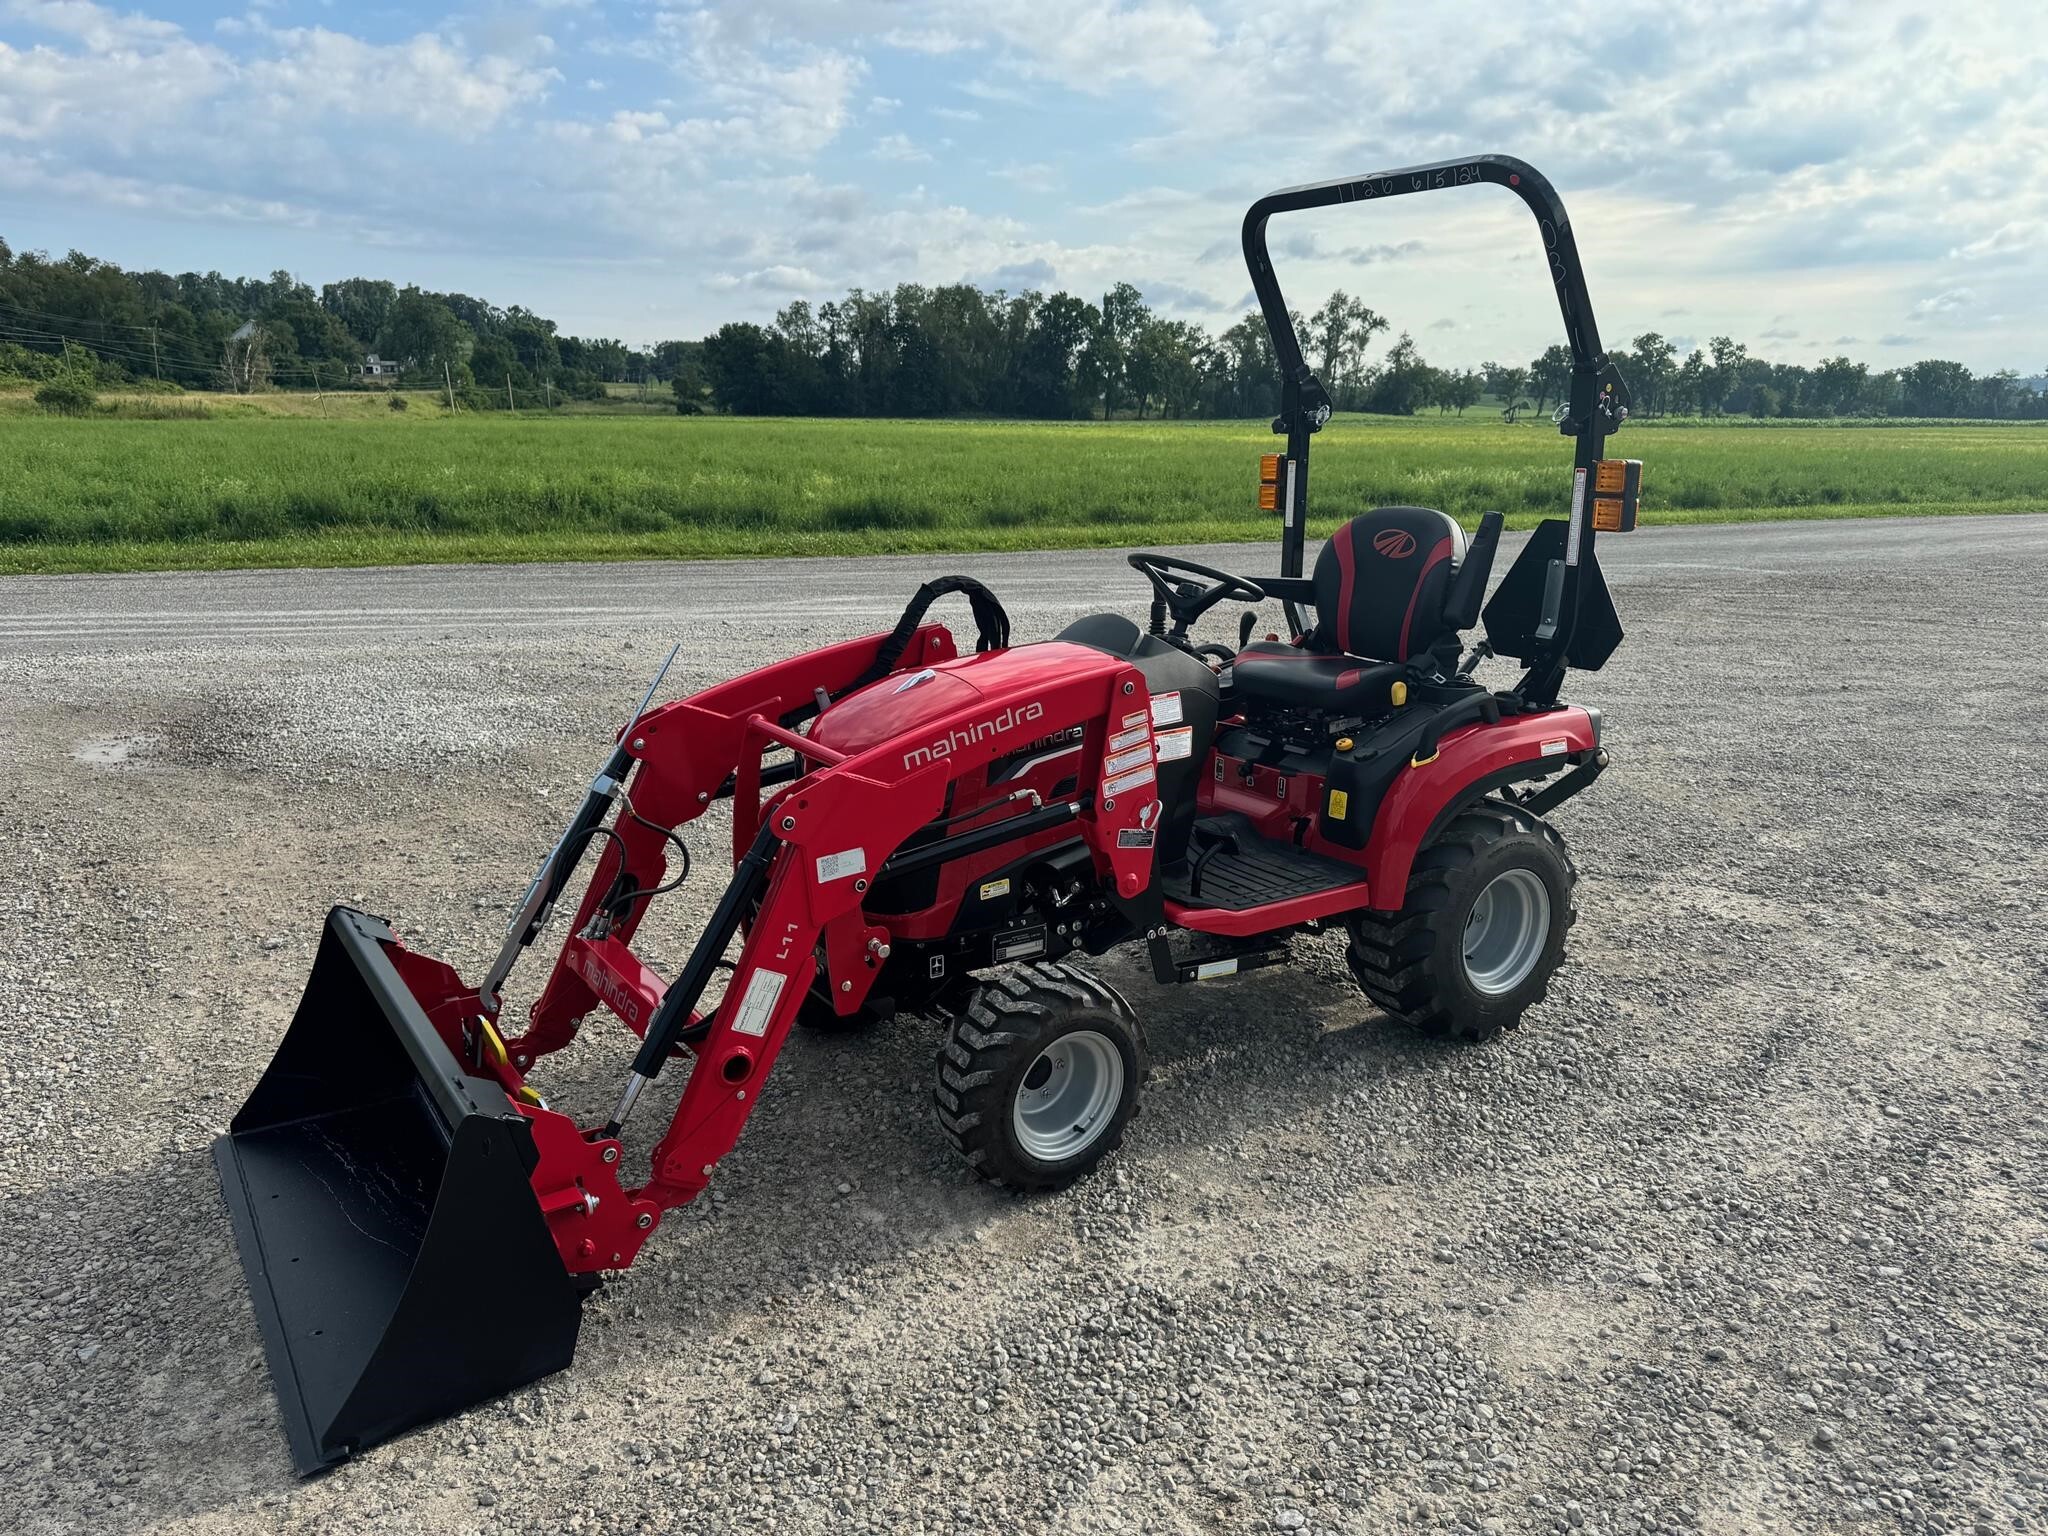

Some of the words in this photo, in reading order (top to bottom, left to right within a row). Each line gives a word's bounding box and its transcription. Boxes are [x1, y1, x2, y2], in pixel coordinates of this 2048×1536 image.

[1337, 177, 1394, 203] 1126
[903, 701, 1044, 771] mahindra
[776, 923, 799, 960] L11
[583, 960, 639, 1022] mahindra
